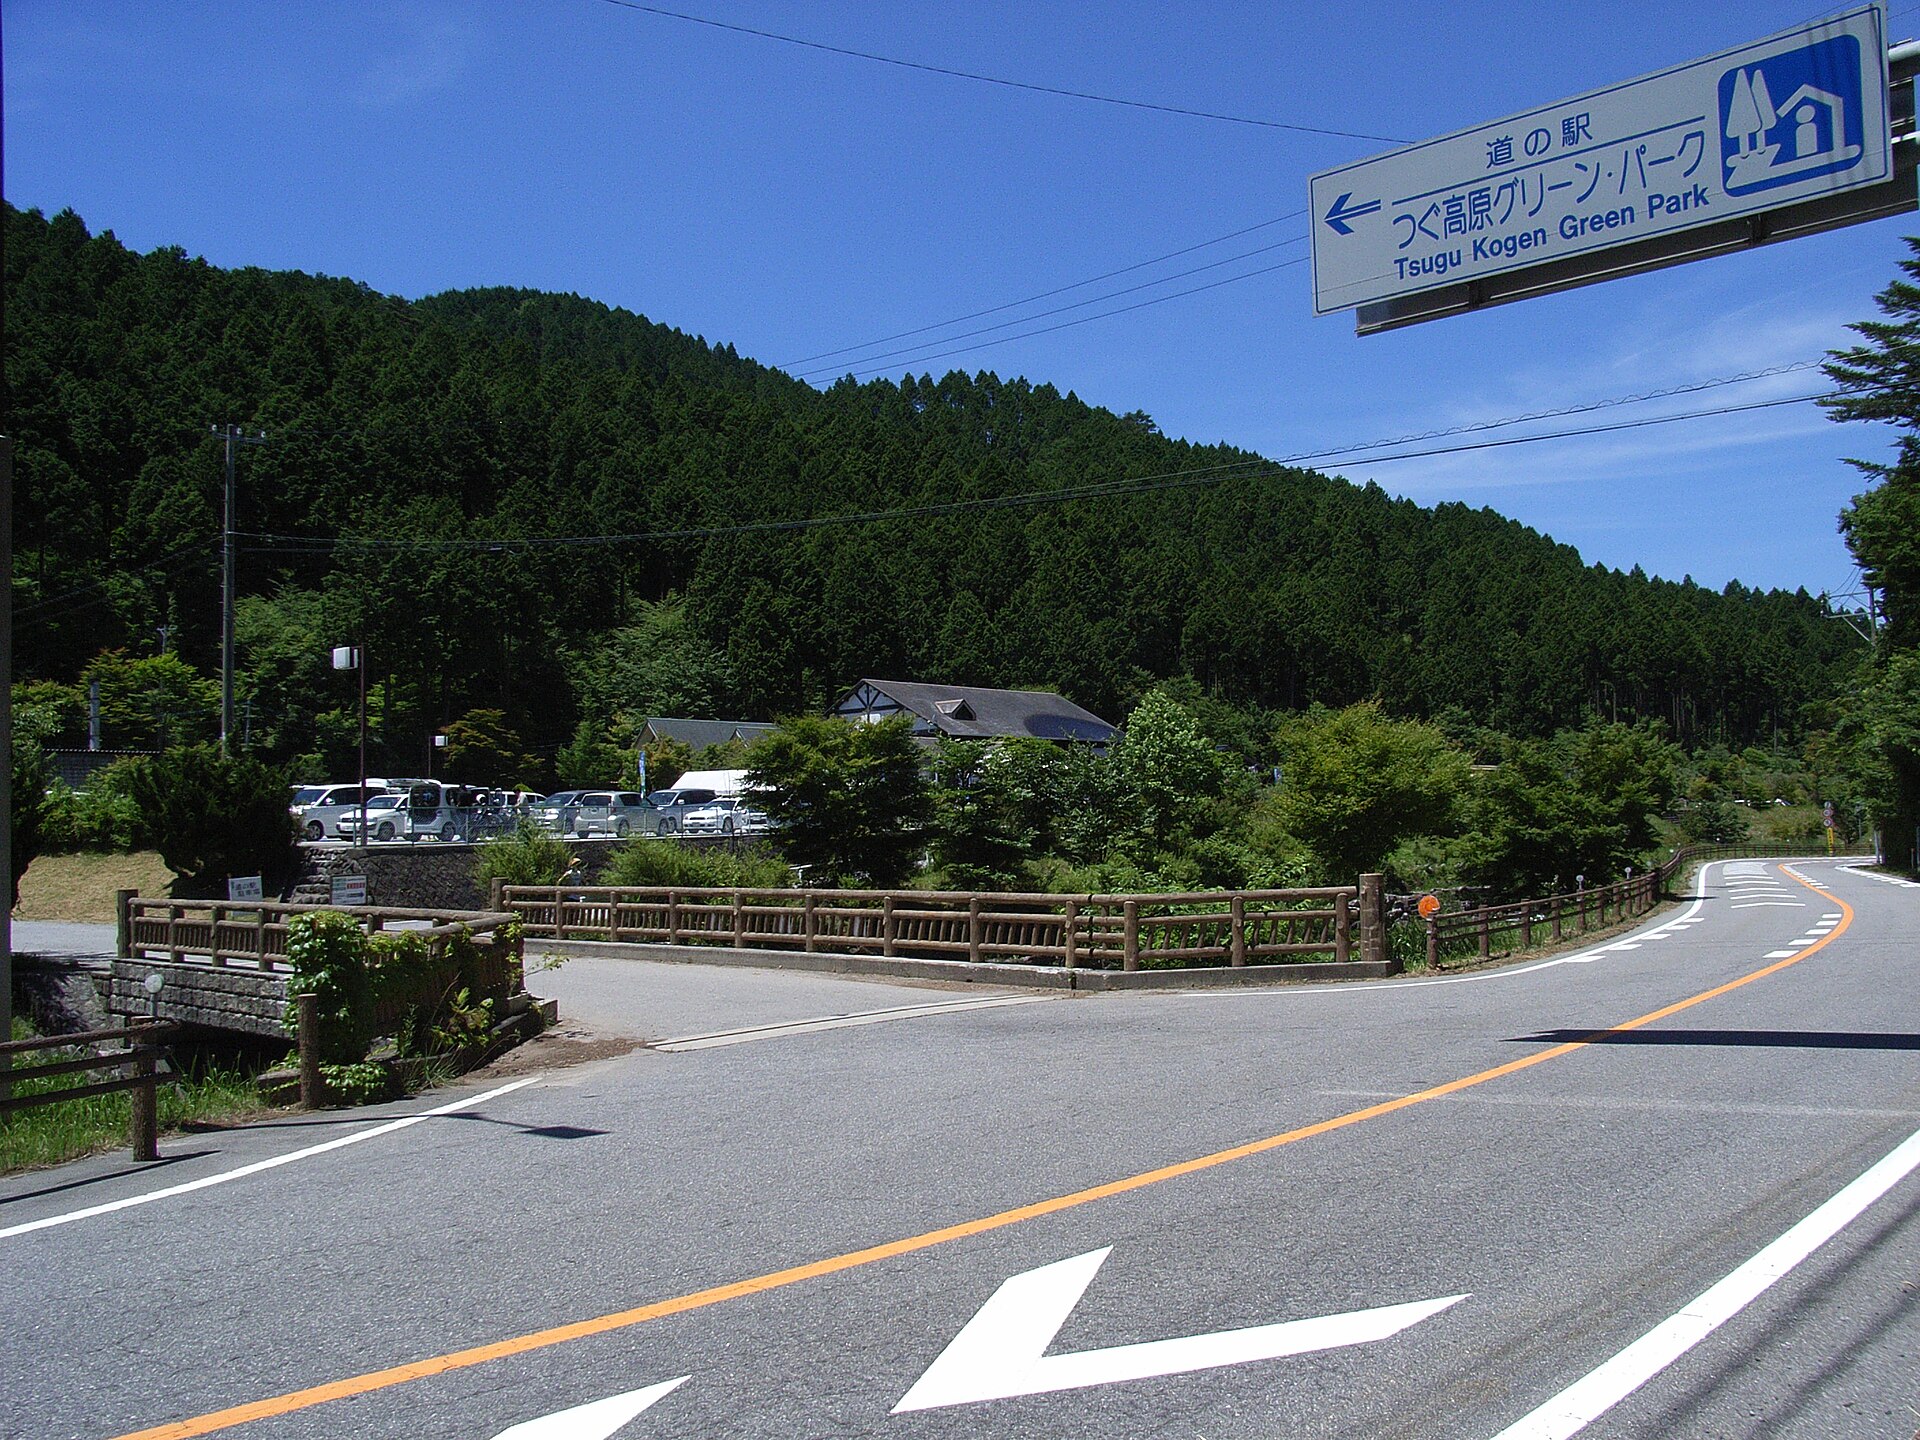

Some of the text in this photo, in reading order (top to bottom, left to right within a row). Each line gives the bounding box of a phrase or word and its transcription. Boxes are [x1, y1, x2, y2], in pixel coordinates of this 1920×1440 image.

[1486, 112, 1593, 169] 道の駅
[1392, 130, 1705, 250] つぐ高原グリーン・パーク
[1394, 183, 1710, 280] Tsugu Kogen Green Park
